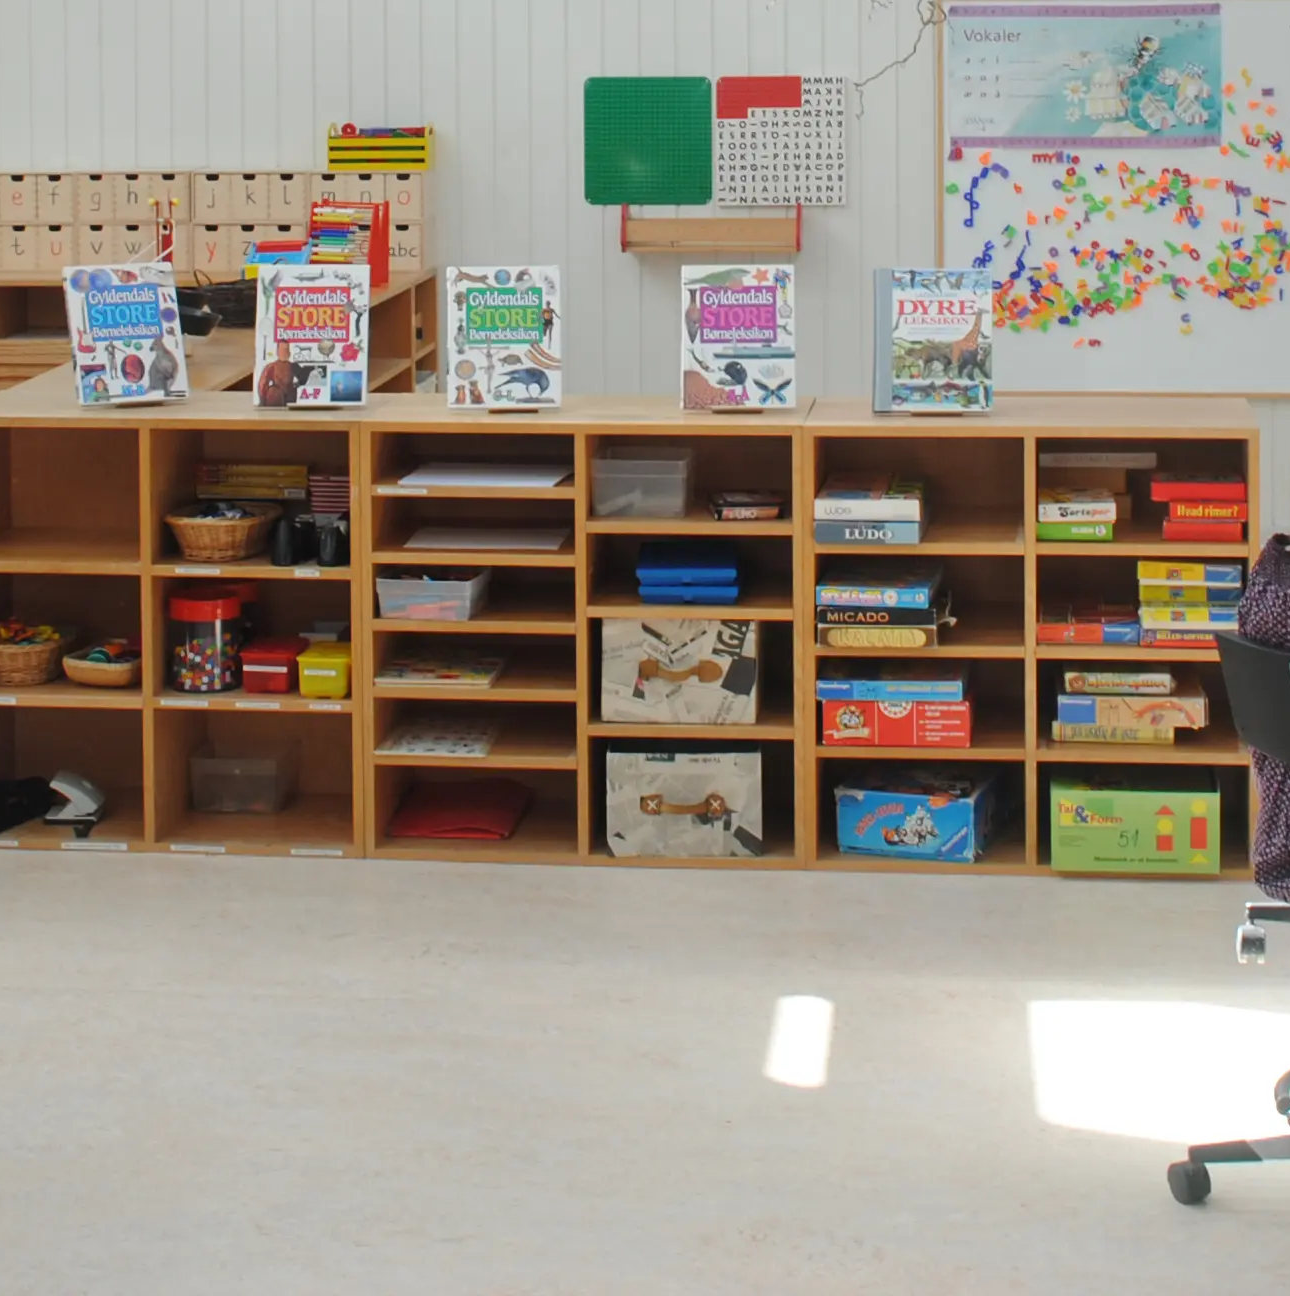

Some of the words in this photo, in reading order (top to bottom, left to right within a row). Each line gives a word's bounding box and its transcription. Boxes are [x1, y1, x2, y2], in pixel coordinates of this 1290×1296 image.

[963, 28, 1022, 43] Vokaler
[12, 191, 23, 206] e
[48, 185, 59, 206] f
[89, 191, 102, 212] g
[126, 184, 138, 205] h
[207, 188, 216, 209] j
[246, 185, 256, 204] k
[283, 185, 292, 204] l
[397, 190, 410, 205] o
[11, 237, 25, 256] t
[50, 241, 62, 256] u
[90, 241, 103, 255] v
[125, 241, 142, 255] w
[206, 241, 217, 263] y
[88, 286, 156, 307] Gyldendals
[278, 289, 347, 307] Gyldendals
[469, 290, 539, 310] Gyldendals
[703, 288, 773, 308] Gyldendals
[91, 304, 158, 325] STORE
[277, 307, 346, 327] STORE
[701, 307, 774, 327] STORE
[897, 299, 977, 316] DYRE
[470, 308, 539, 328] STORE
[904, 316, 969, 325] LEKSIKON
[300, 388, 321, 400] A-F
[1177, 505, 1204, 517] Hvad
[1205, 505, 1239, 517] rimer?
[844, 527, 893, 540] LUDO
[826, 611, 890, 623] MICADO
[1058, 803, 1076, 814] Tal
[1074, 805, 1089, 824] &
[1089, 814, 1123, 825] Form
